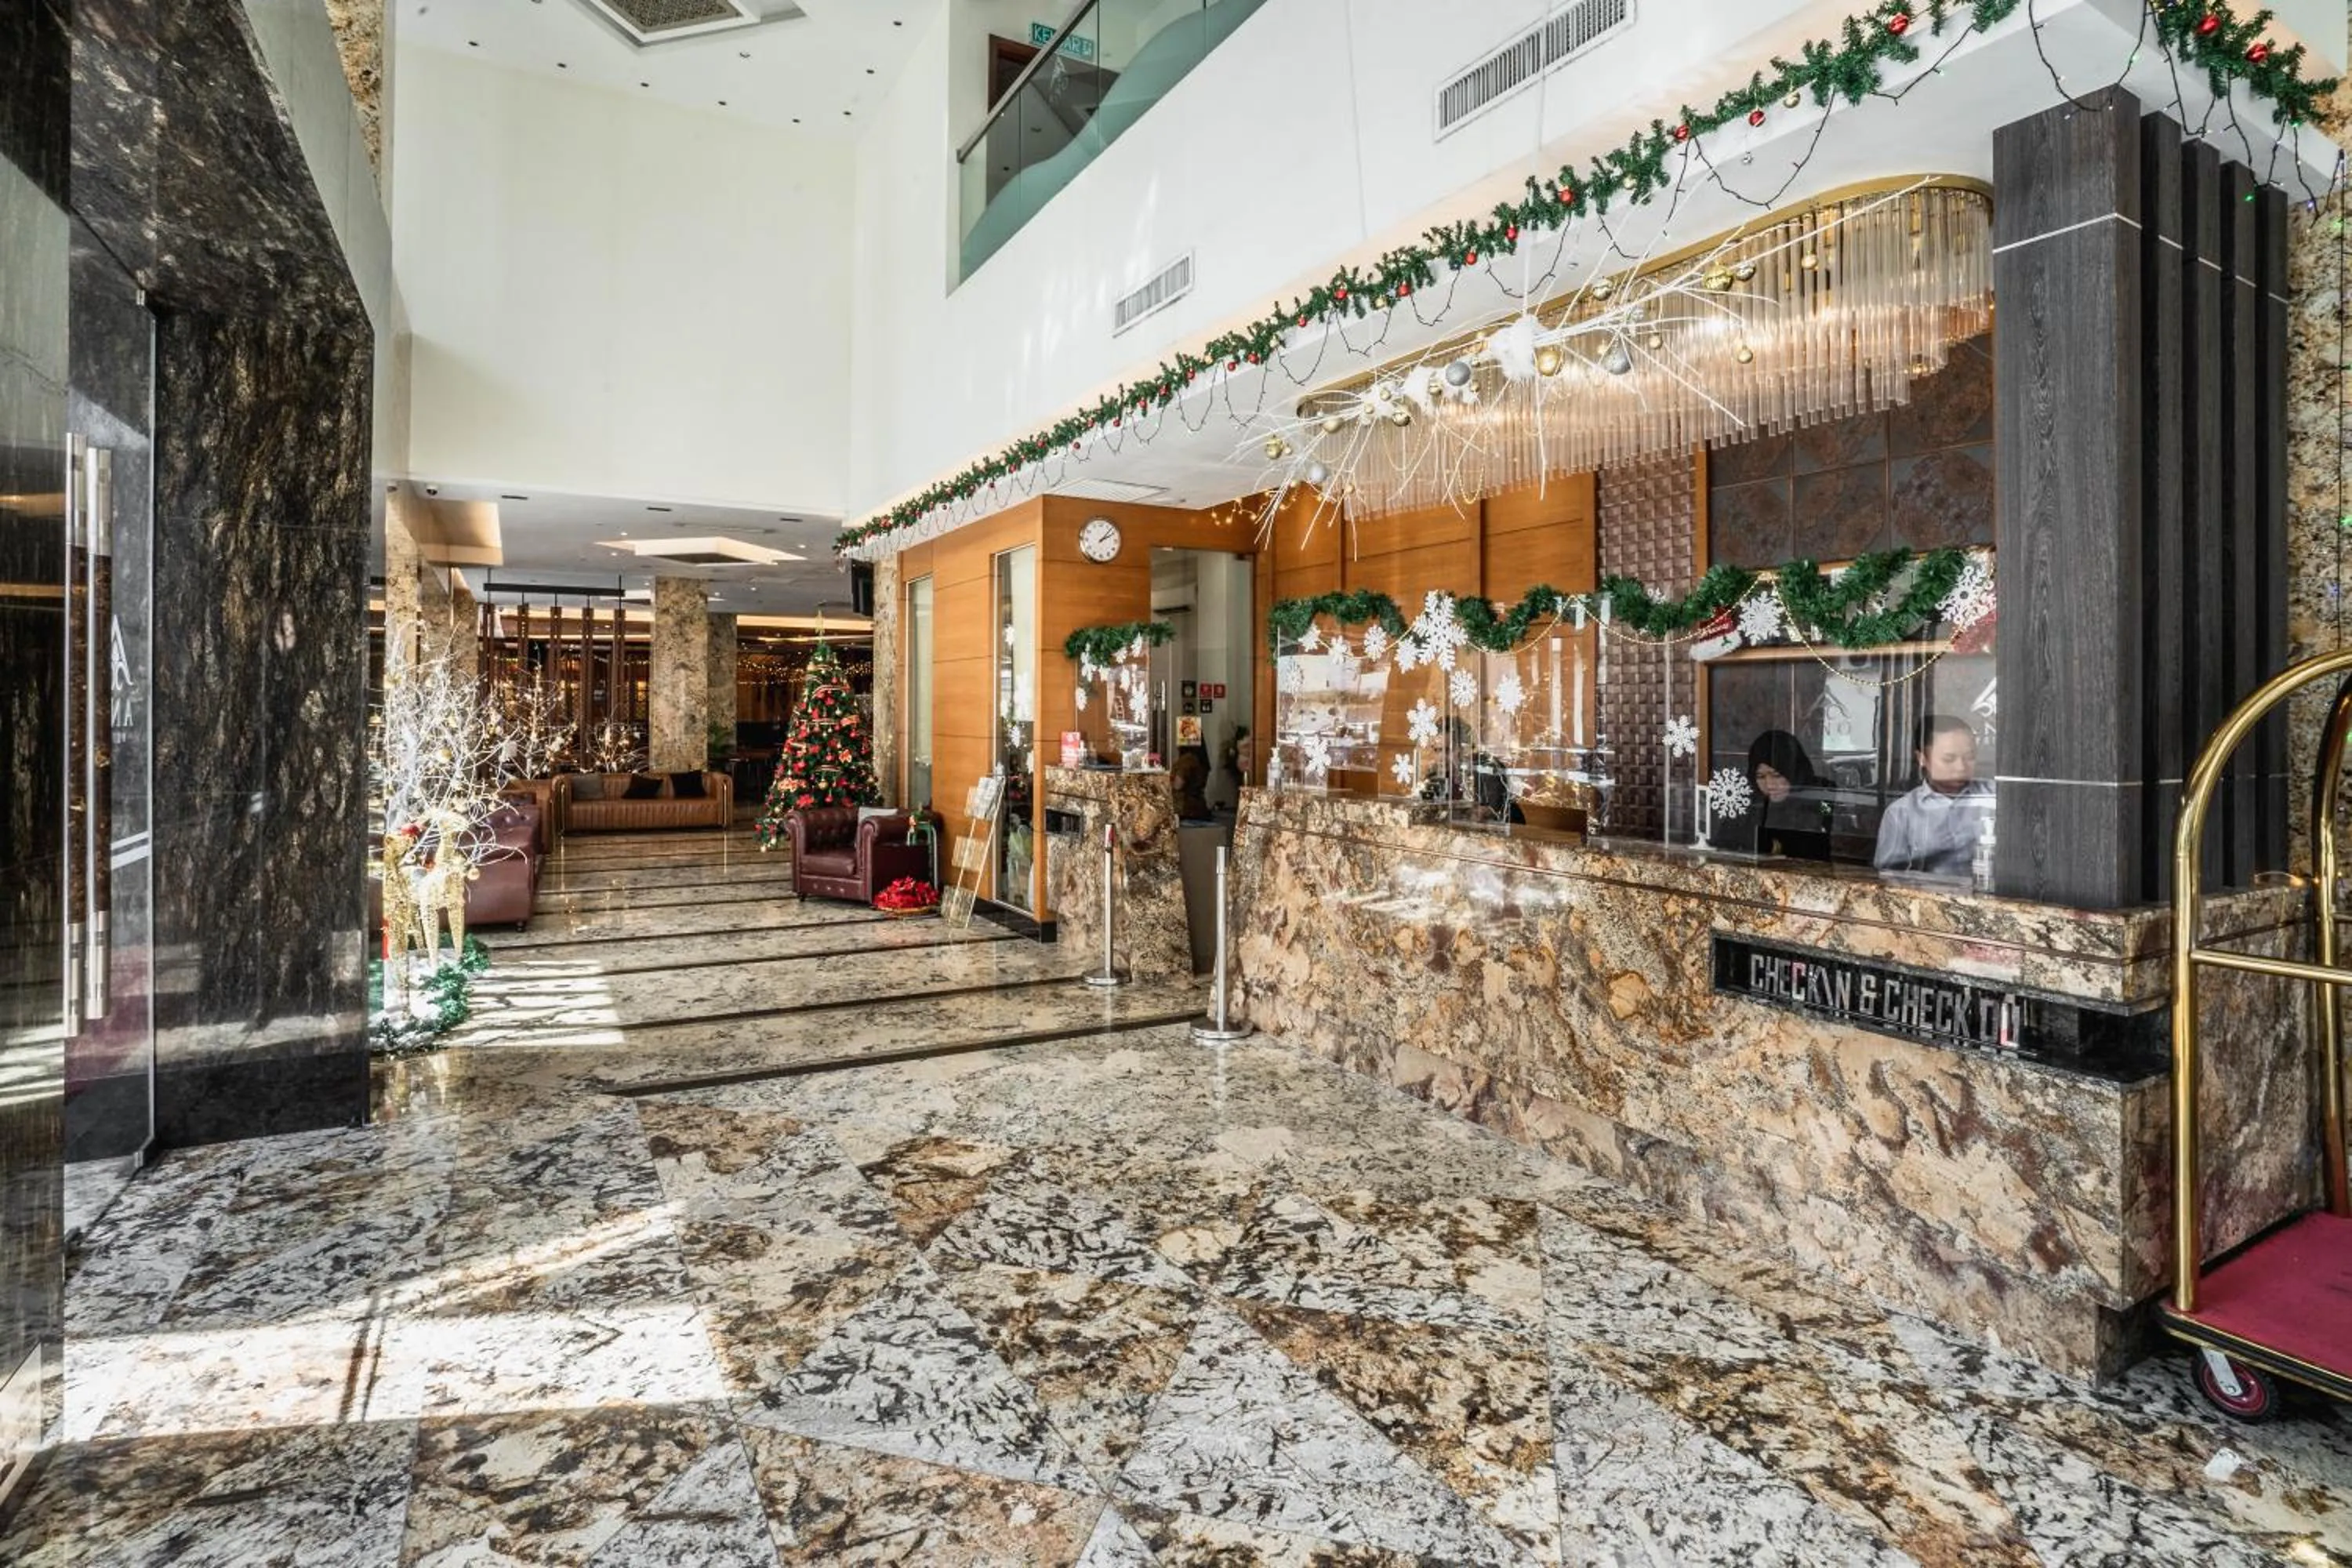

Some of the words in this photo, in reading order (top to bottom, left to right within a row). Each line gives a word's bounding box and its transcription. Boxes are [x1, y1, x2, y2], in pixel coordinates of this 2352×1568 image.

[1034, 24, 1082, 53] KEAR
[1751, 953, 1821, 1004] CHECK
[1859, 974, 1878, 1015] &
[1883, 979, 1972, 1039] CHECK
